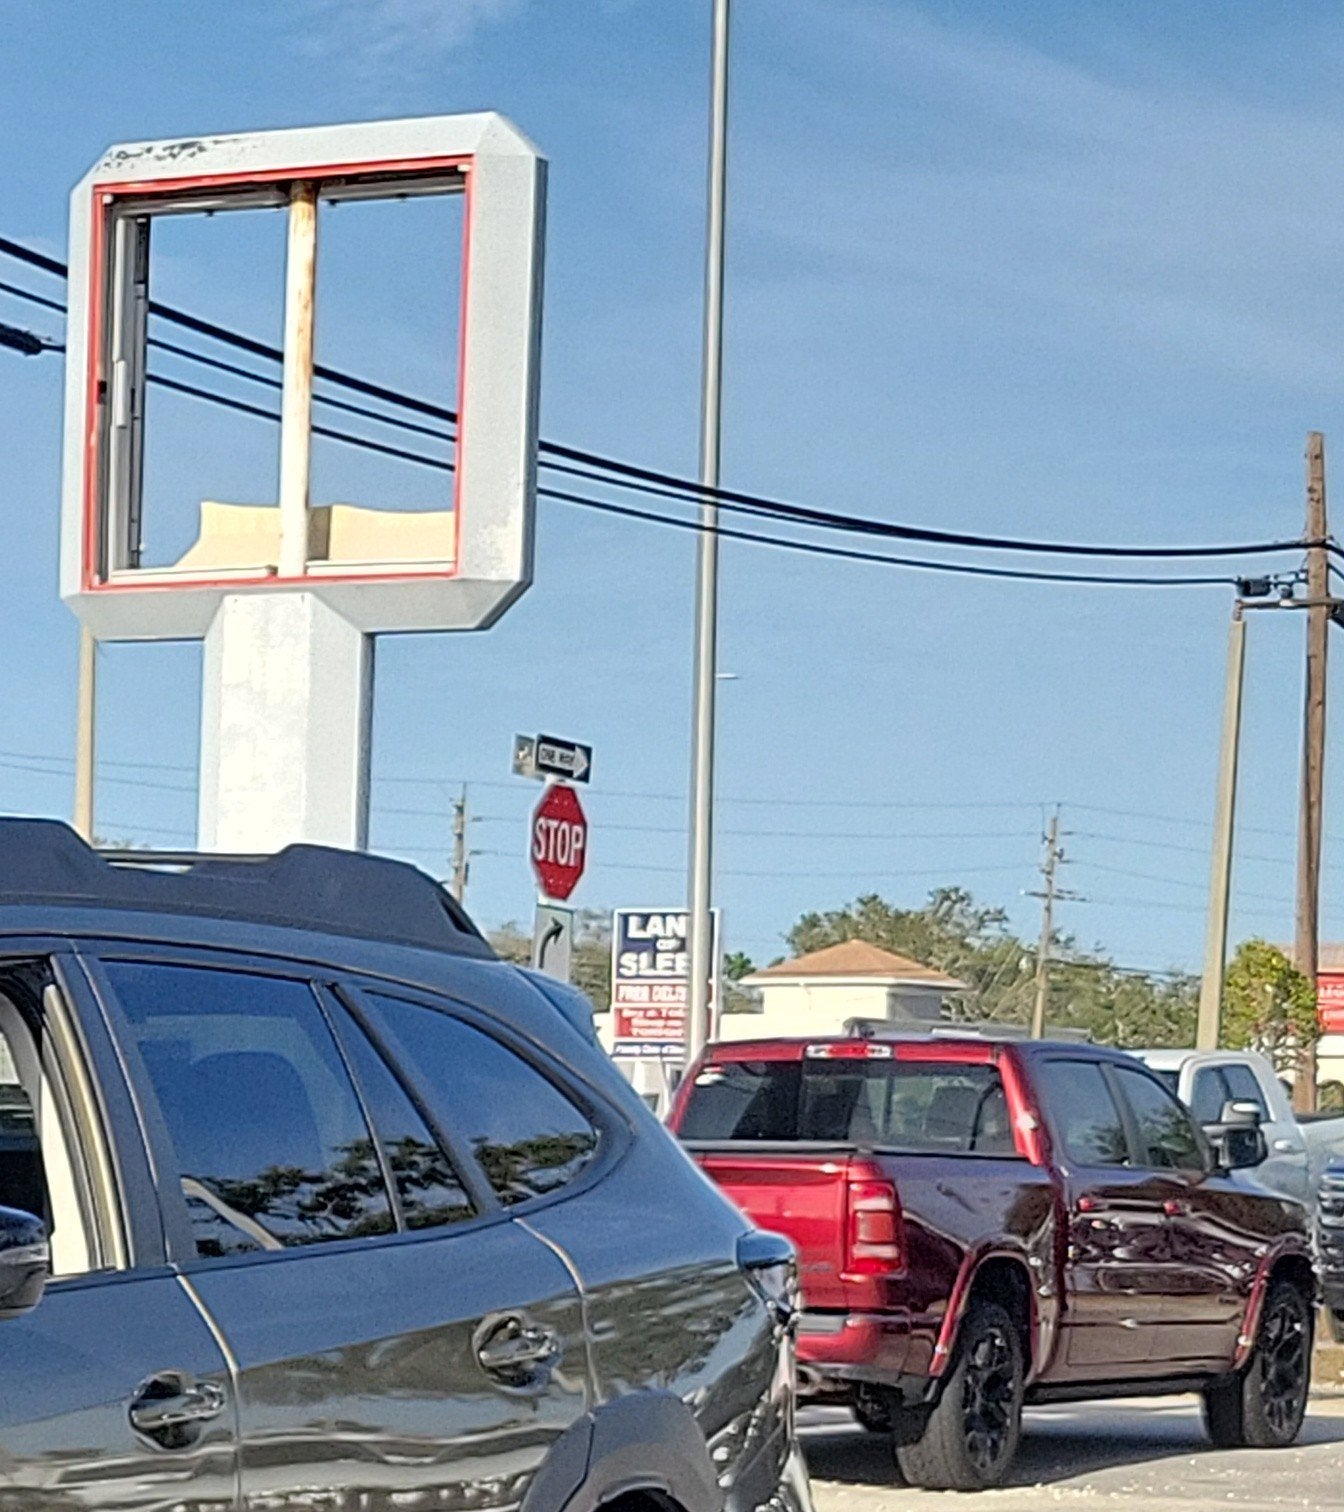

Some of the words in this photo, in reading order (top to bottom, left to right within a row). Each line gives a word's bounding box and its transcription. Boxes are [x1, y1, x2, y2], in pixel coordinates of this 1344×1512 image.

[534, 817, 584, 867] STOP
[627, 915, 687, 939] LAN
[619, 952, 690, 977] SLEE
